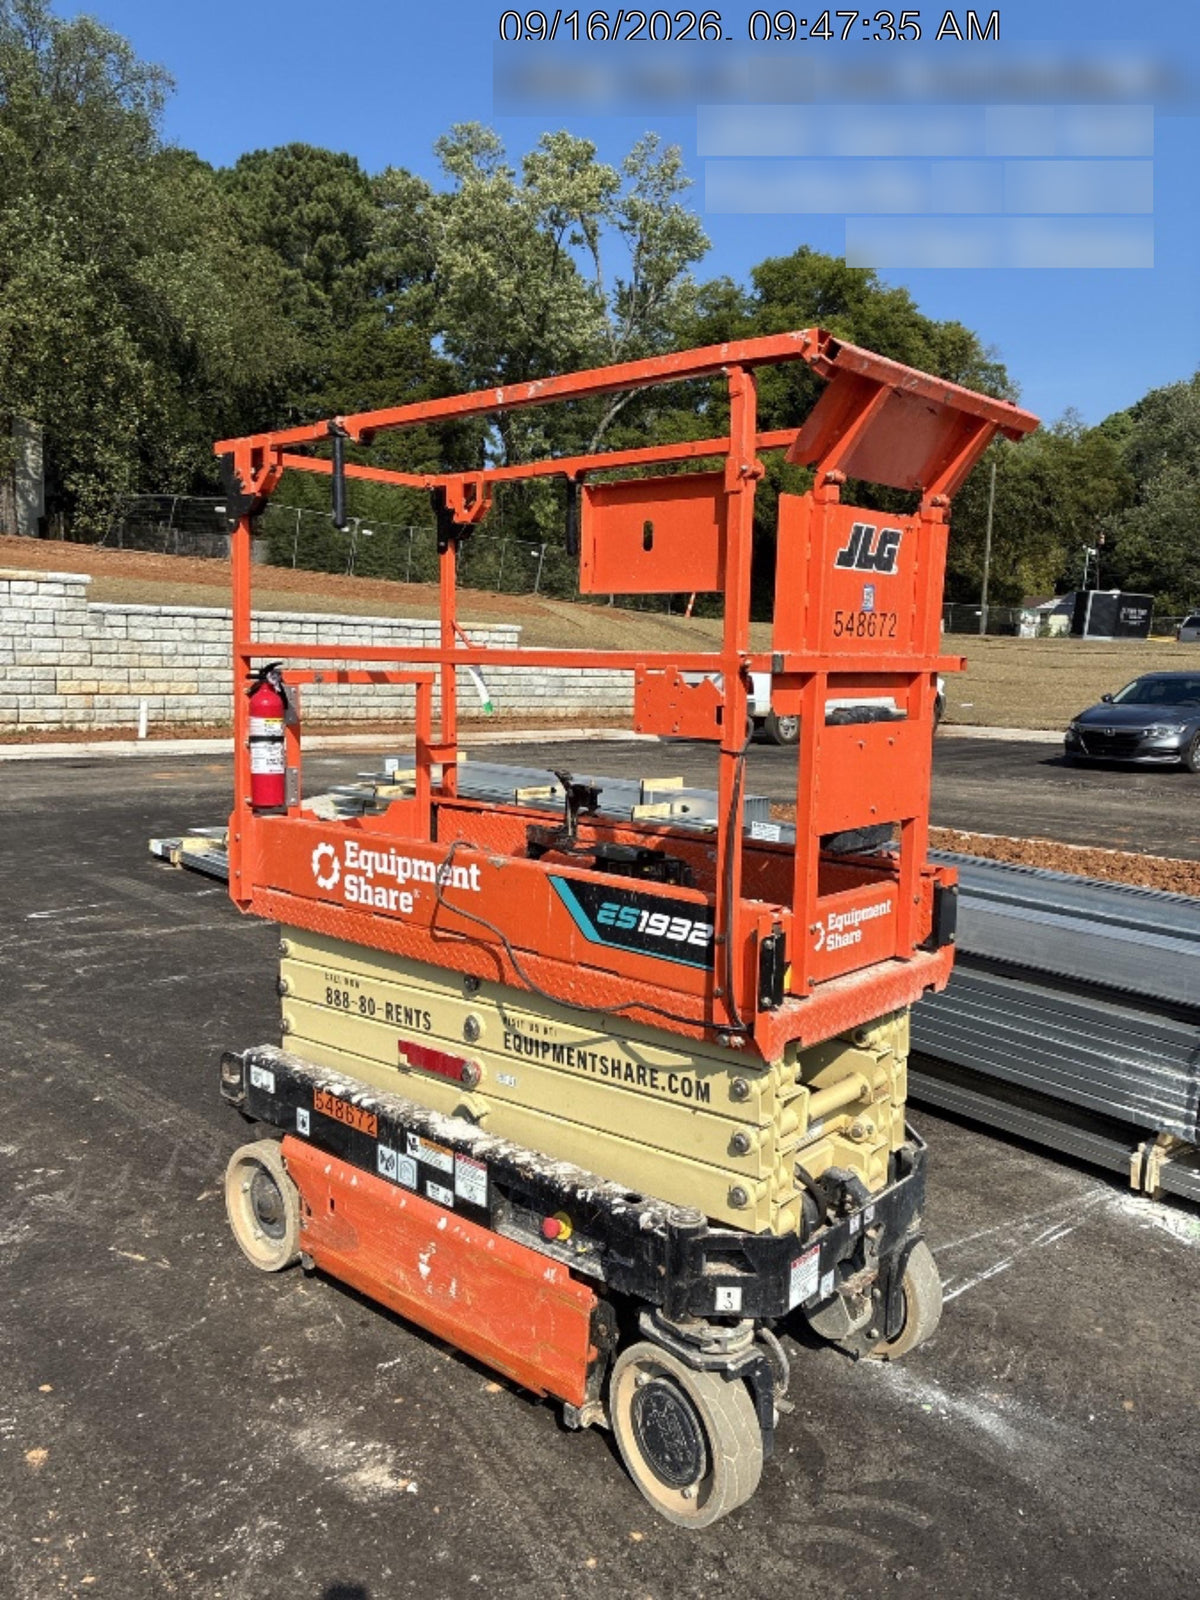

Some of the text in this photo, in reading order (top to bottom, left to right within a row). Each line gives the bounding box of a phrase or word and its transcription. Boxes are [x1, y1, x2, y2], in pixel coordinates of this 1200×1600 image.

[834, 522, 903, 575] JLG
[833, 611, 897, 637] 548672
[344, 840, 481, 891] Equipment
[344, 874, 414, 914] Share
[827, 899, 892, 932] Equipment
[596, 902, 714, 947] ES1932
[826, 929, 862, 952] Share
[325, 986, 432, 1031] 888-80-RENTS
[503, 1030, 711, 1103] EQUIPMENTSHARE.COM
[314, 1089, 376, 1135] 548672
